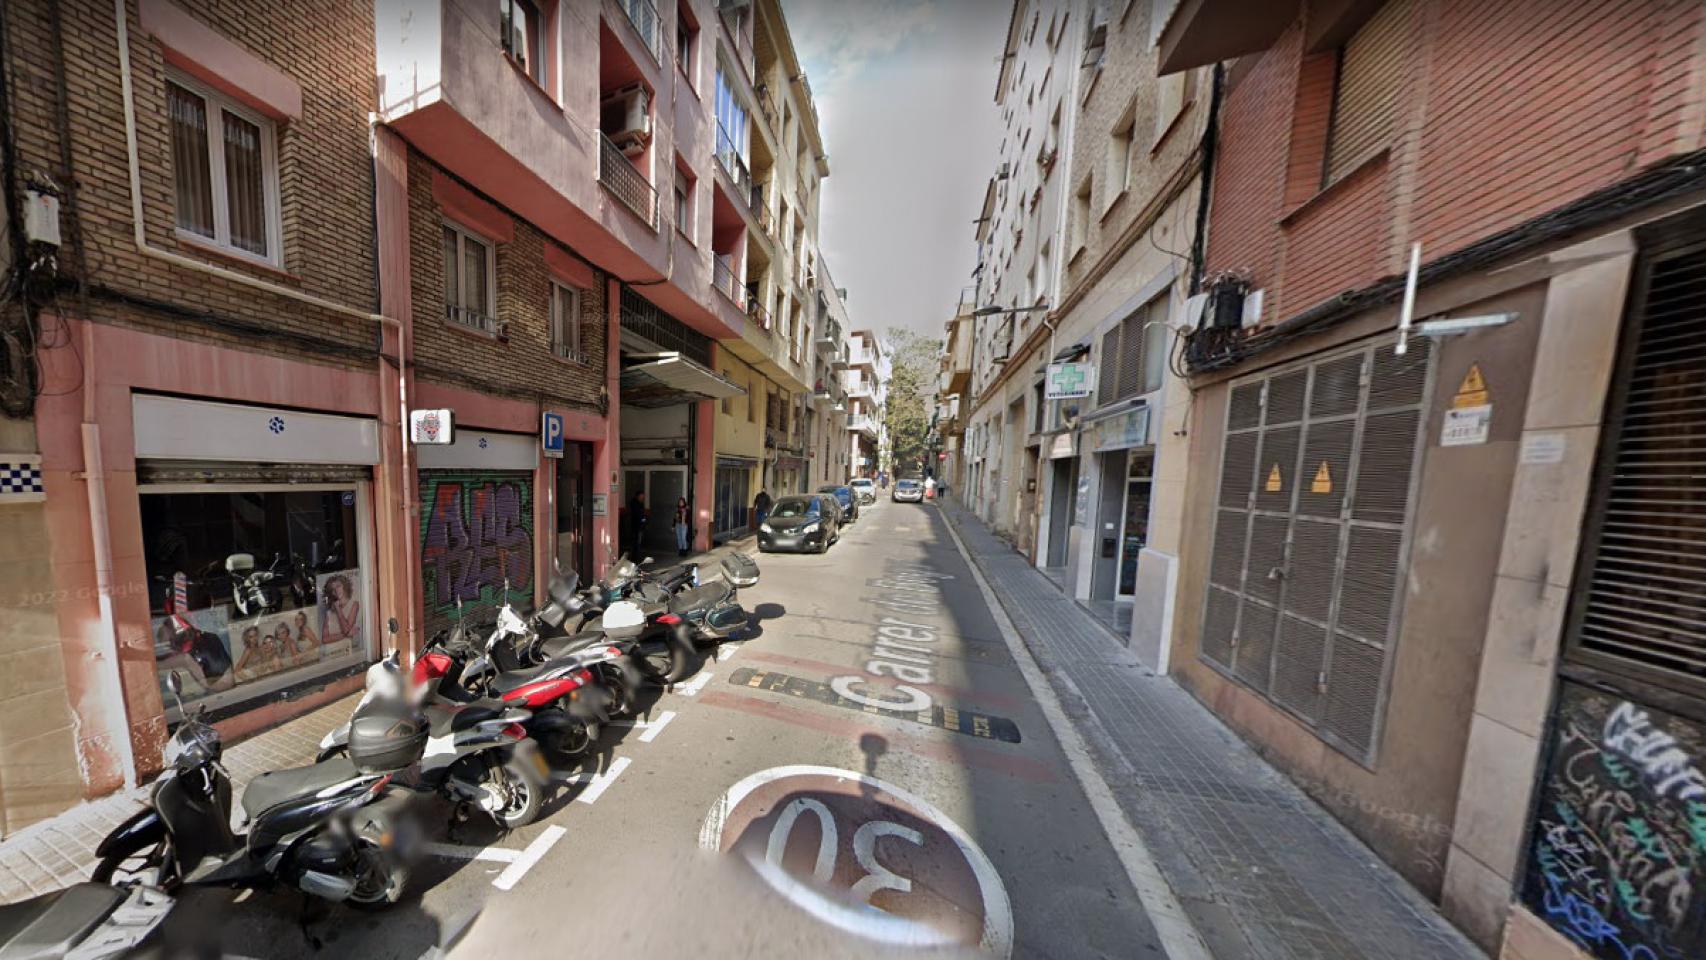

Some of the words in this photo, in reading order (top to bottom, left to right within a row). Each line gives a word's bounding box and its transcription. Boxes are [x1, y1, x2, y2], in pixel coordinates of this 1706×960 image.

[549, 417, 560, 447] P
[831, 617, 937, 711] Carrer
[766, 798, 924, 903] 30
